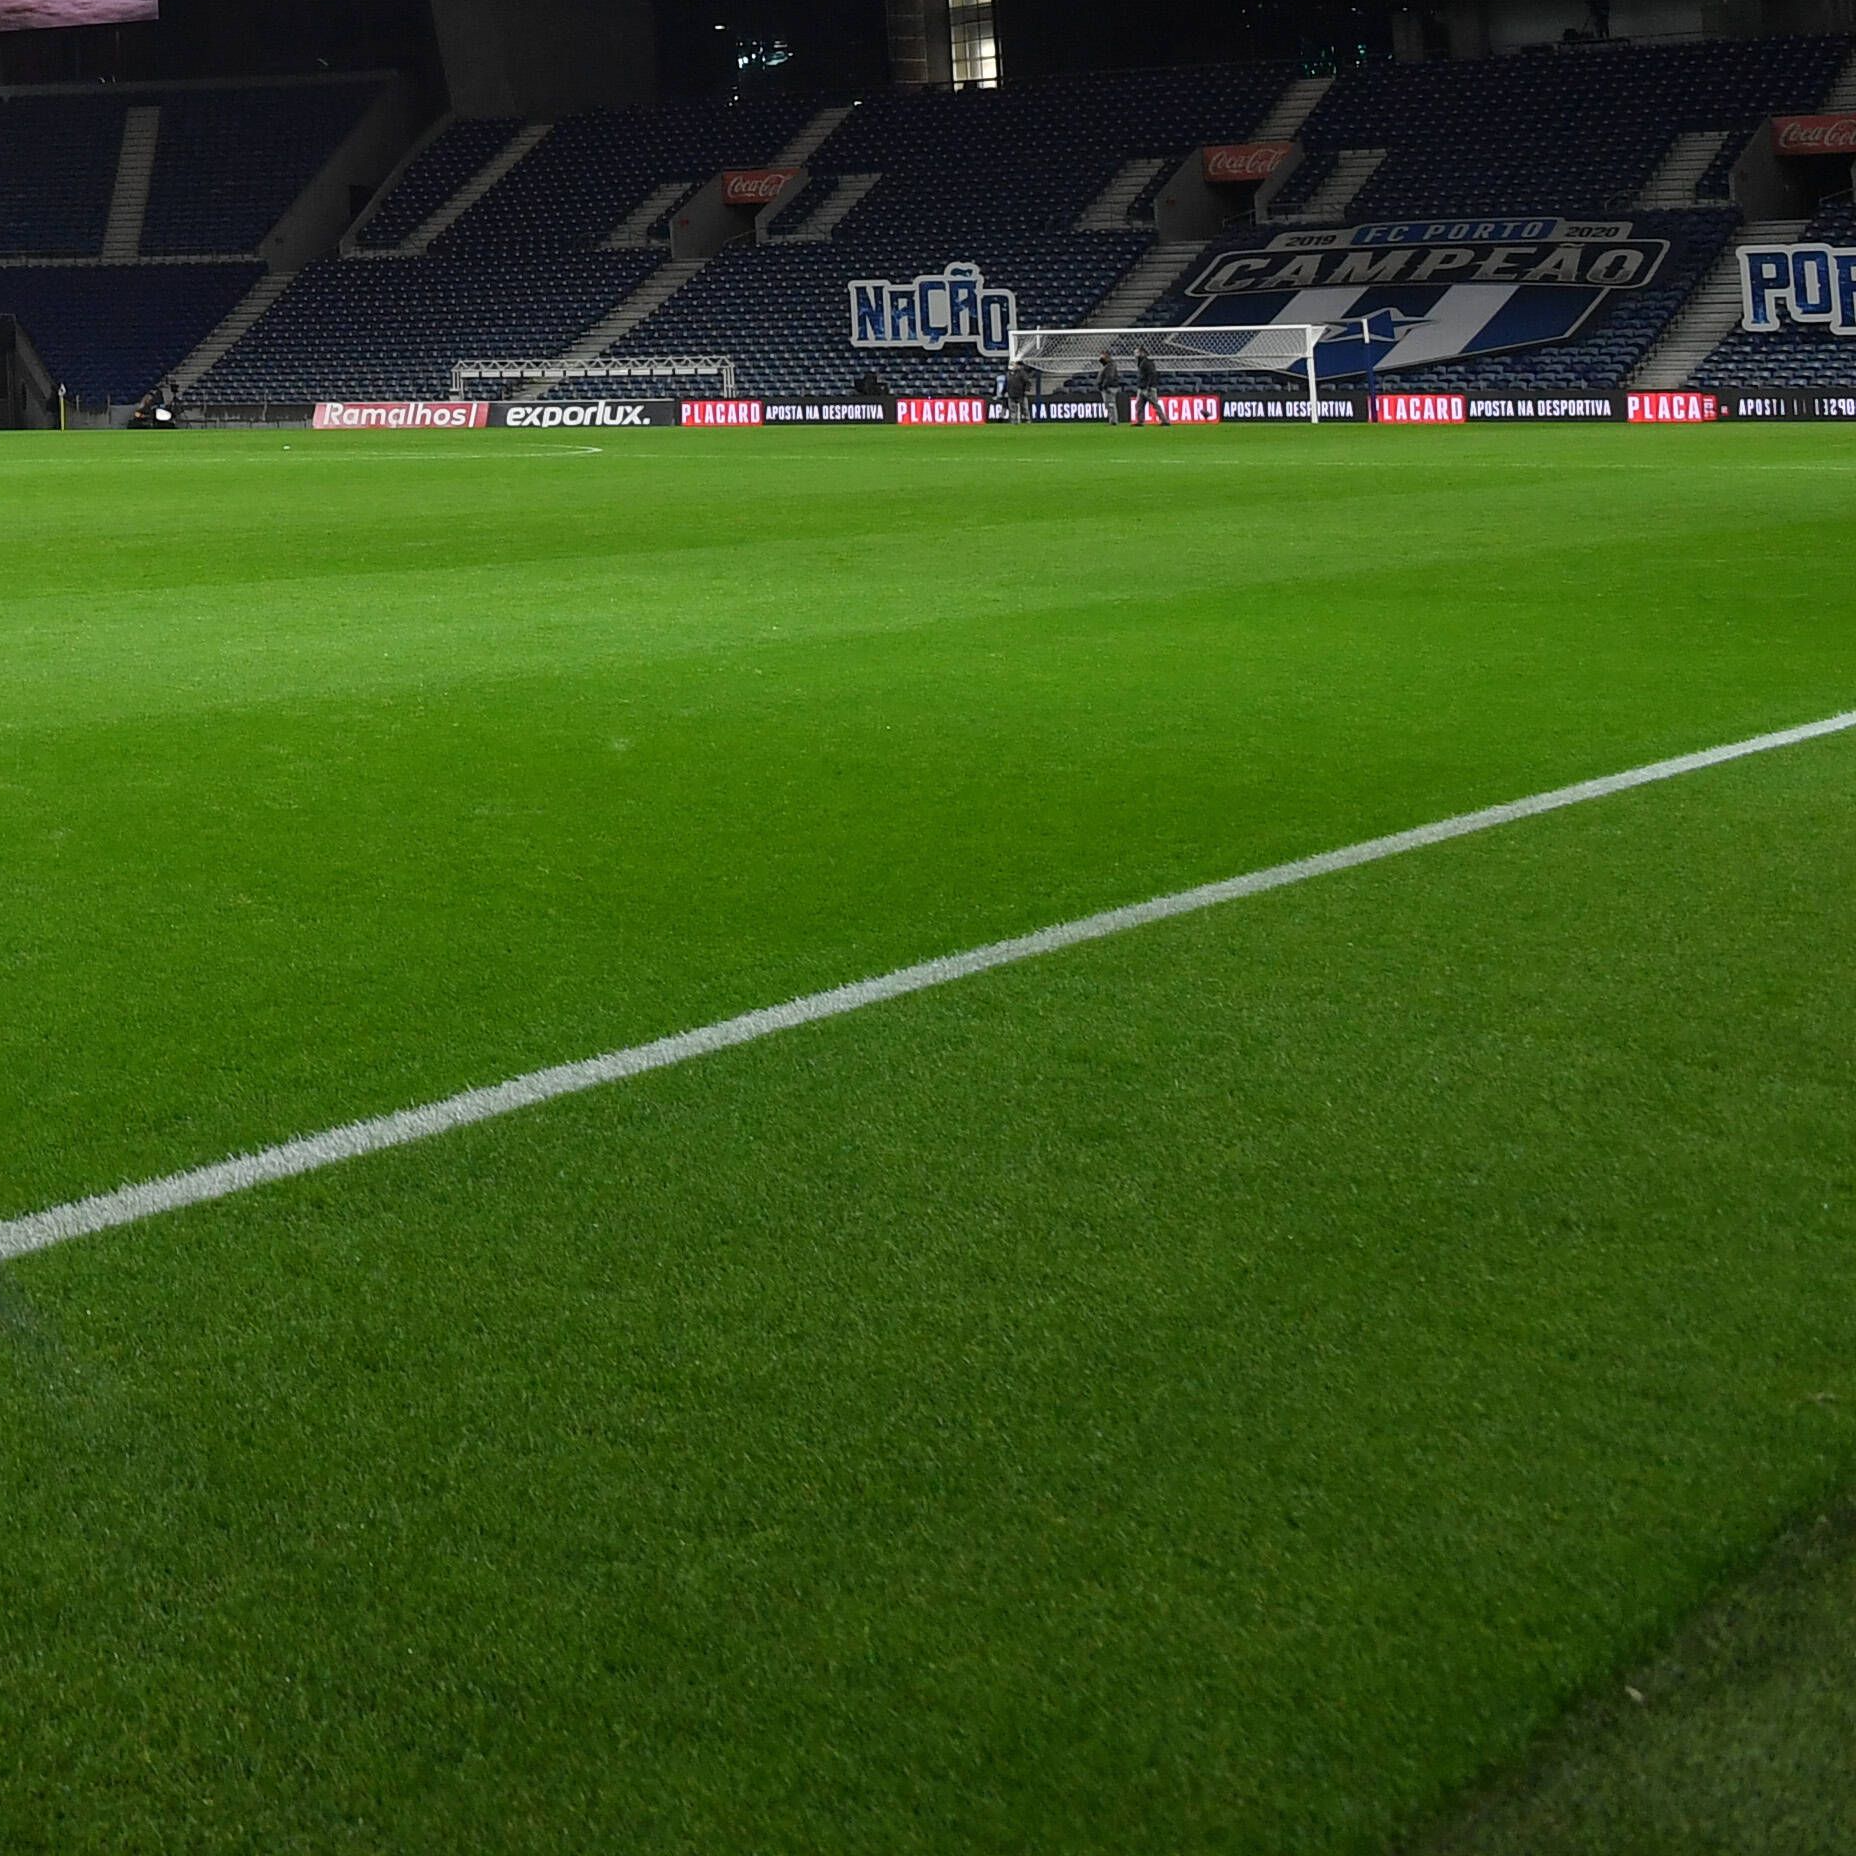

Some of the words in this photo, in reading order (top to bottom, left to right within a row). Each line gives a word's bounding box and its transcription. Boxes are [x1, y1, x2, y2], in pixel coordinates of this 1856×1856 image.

[1287, 234, 1337, 247] 2019
[1363, 225, 1404, 243] FC
[1422, 221, 1545, 241] PORTO
[1565, 225, 1620, 239] 2020
[1204, 242, 1646, 292] CAMPEÃO
[851, 262, 1015, 354] NAÇÃO
[680, 401, 761, 424] PLACARD
[766, 405, 803, 420] APOSTA
[806, 405, 820, 420] NA
[822, 404, 884, 420] DESPORTIVA
[896, 401, 983, 423] PLACARD
[1050, 403, 1108, 419] DESPORTIV
[1223, 401, 1265, 417] APOSTA
[1268, 401, 1283, 417] NA
[1469, 400, 1514, 417] APOSTA
[1518, 400, 1534, 416] NA
[1537, 399, 1612, 416] DESPORTIVA
